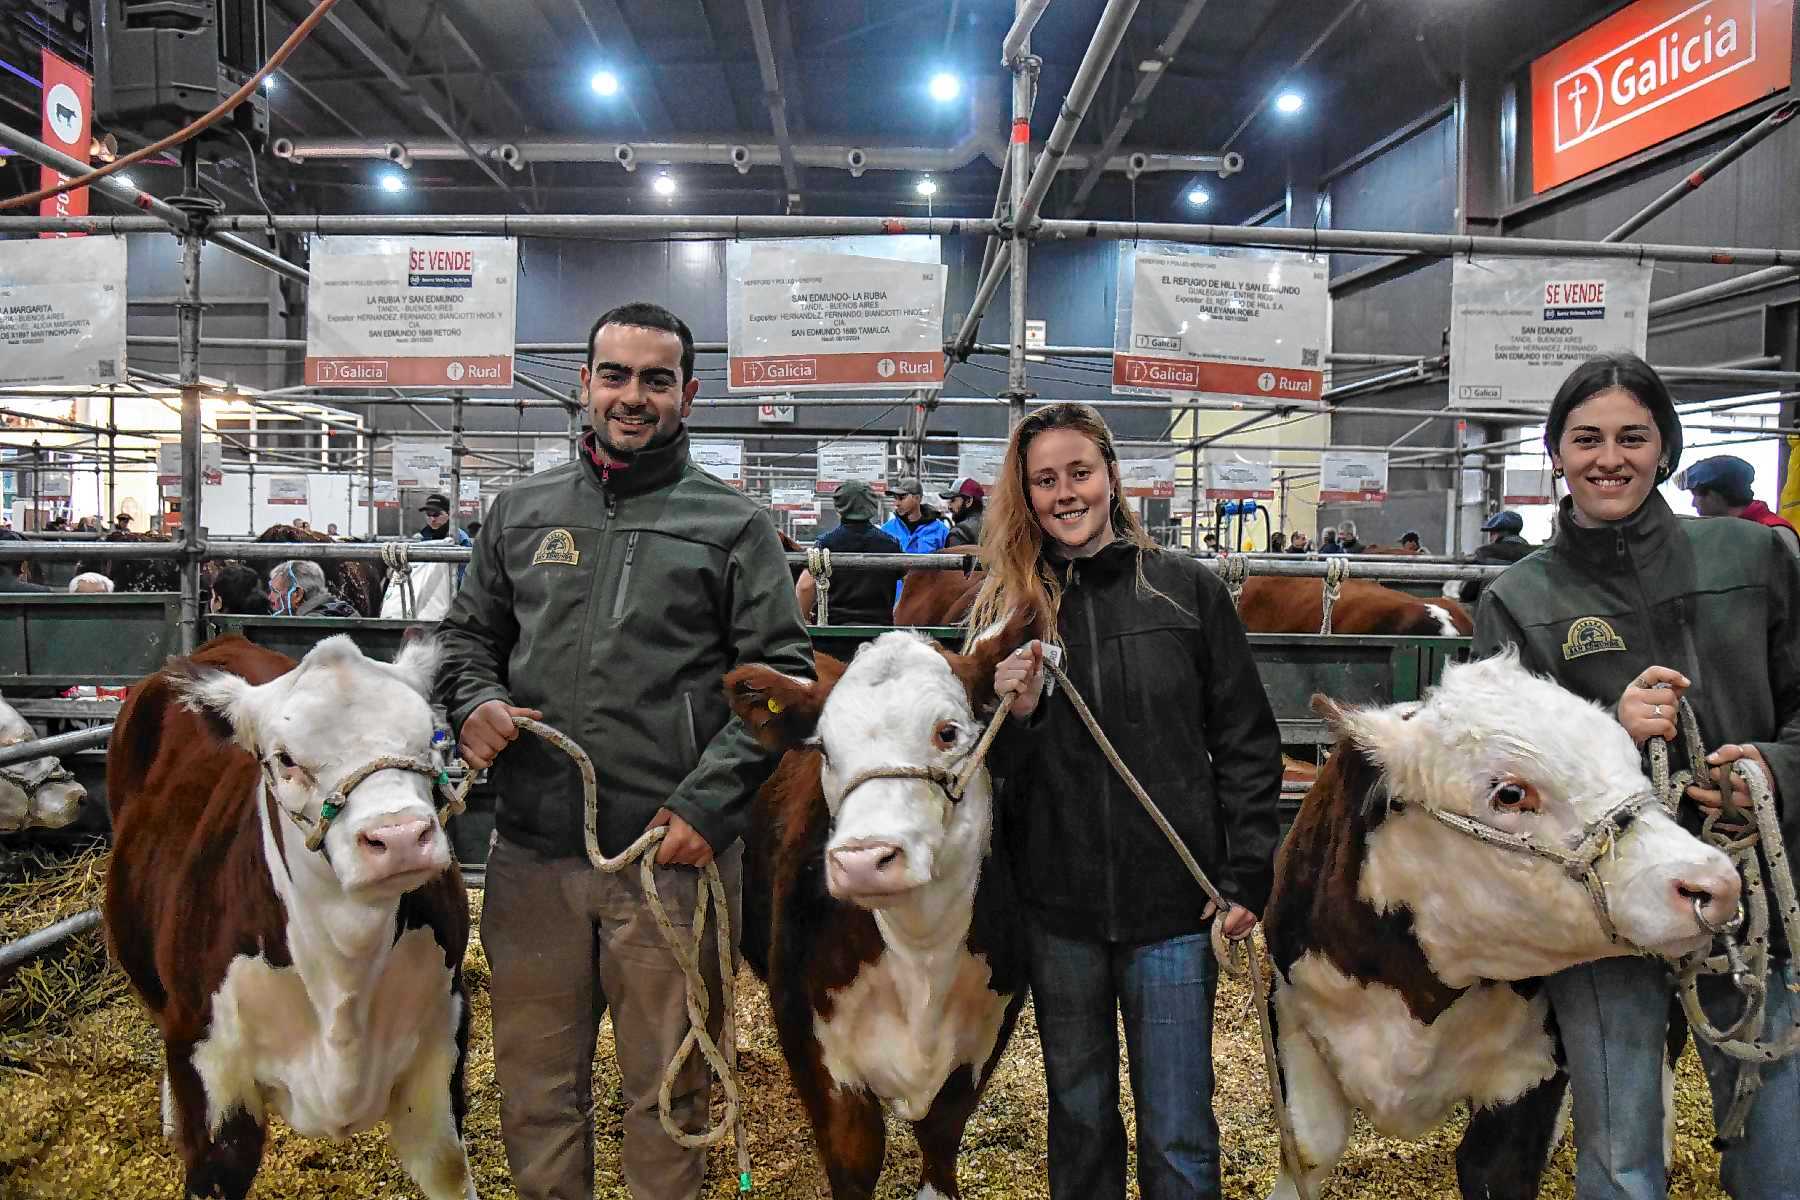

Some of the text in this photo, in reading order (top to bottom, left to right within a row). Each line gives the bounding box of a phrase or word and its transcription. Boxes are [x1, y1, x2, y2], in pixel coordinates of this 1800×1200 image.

[1611, 15, 1737, 106] Galicia
[410, 250, 471, 270] SE VENDE
[1162, 276, 1172, 285] EL
[1173, 277, 1208, 288] REFUGIO
[1209, 280, 1220, 289] DE
[1221, 281, 1238, 290] HILL
[1239, 281, 1245, 291] Y
[1245, 282, 1261, 292] SAN
[367, 294, 464, 305] LA RUBIA Y SAN EDMUNDO
[792, 294, 807, 303] SAN
[852, 292, 862, 301] LA
[863, 291, 887, 300] RUBIA
[1546, 284, 1604, 304] SE VENDE
[10, 304, 53, 314] MARGARITA
[405, 304, 432, 312] BUENOS
[434, 304, 453, 312] AIRES
[829, 302, 858, 310] BUENOS
[859, 301, 880, 309] AIRES
[54, 319, 90, 328] MARGARITA
[369, 330, 382, 338] SAN
[383, 329, 417, 338] EDMUNDO
[792, 330, 806, 338] SAN
[807, 328, 841, 337] EDMUNDO
[1521, 326, 1573, 335] SAN EDMUNDO
[1151, 338, 1177, 349] Galicia
[1495, 353, 1508, 361] SAN
[1509, 353, 1541, 361] EDMUNDO
[340, 363, 502, 379] Galicia Rural
[767, 360, 933, 378] Galicia Rural
[1150, 366, 1312, 393] Galicia Rural
[1474, 389, 1498, 398] Galicia
